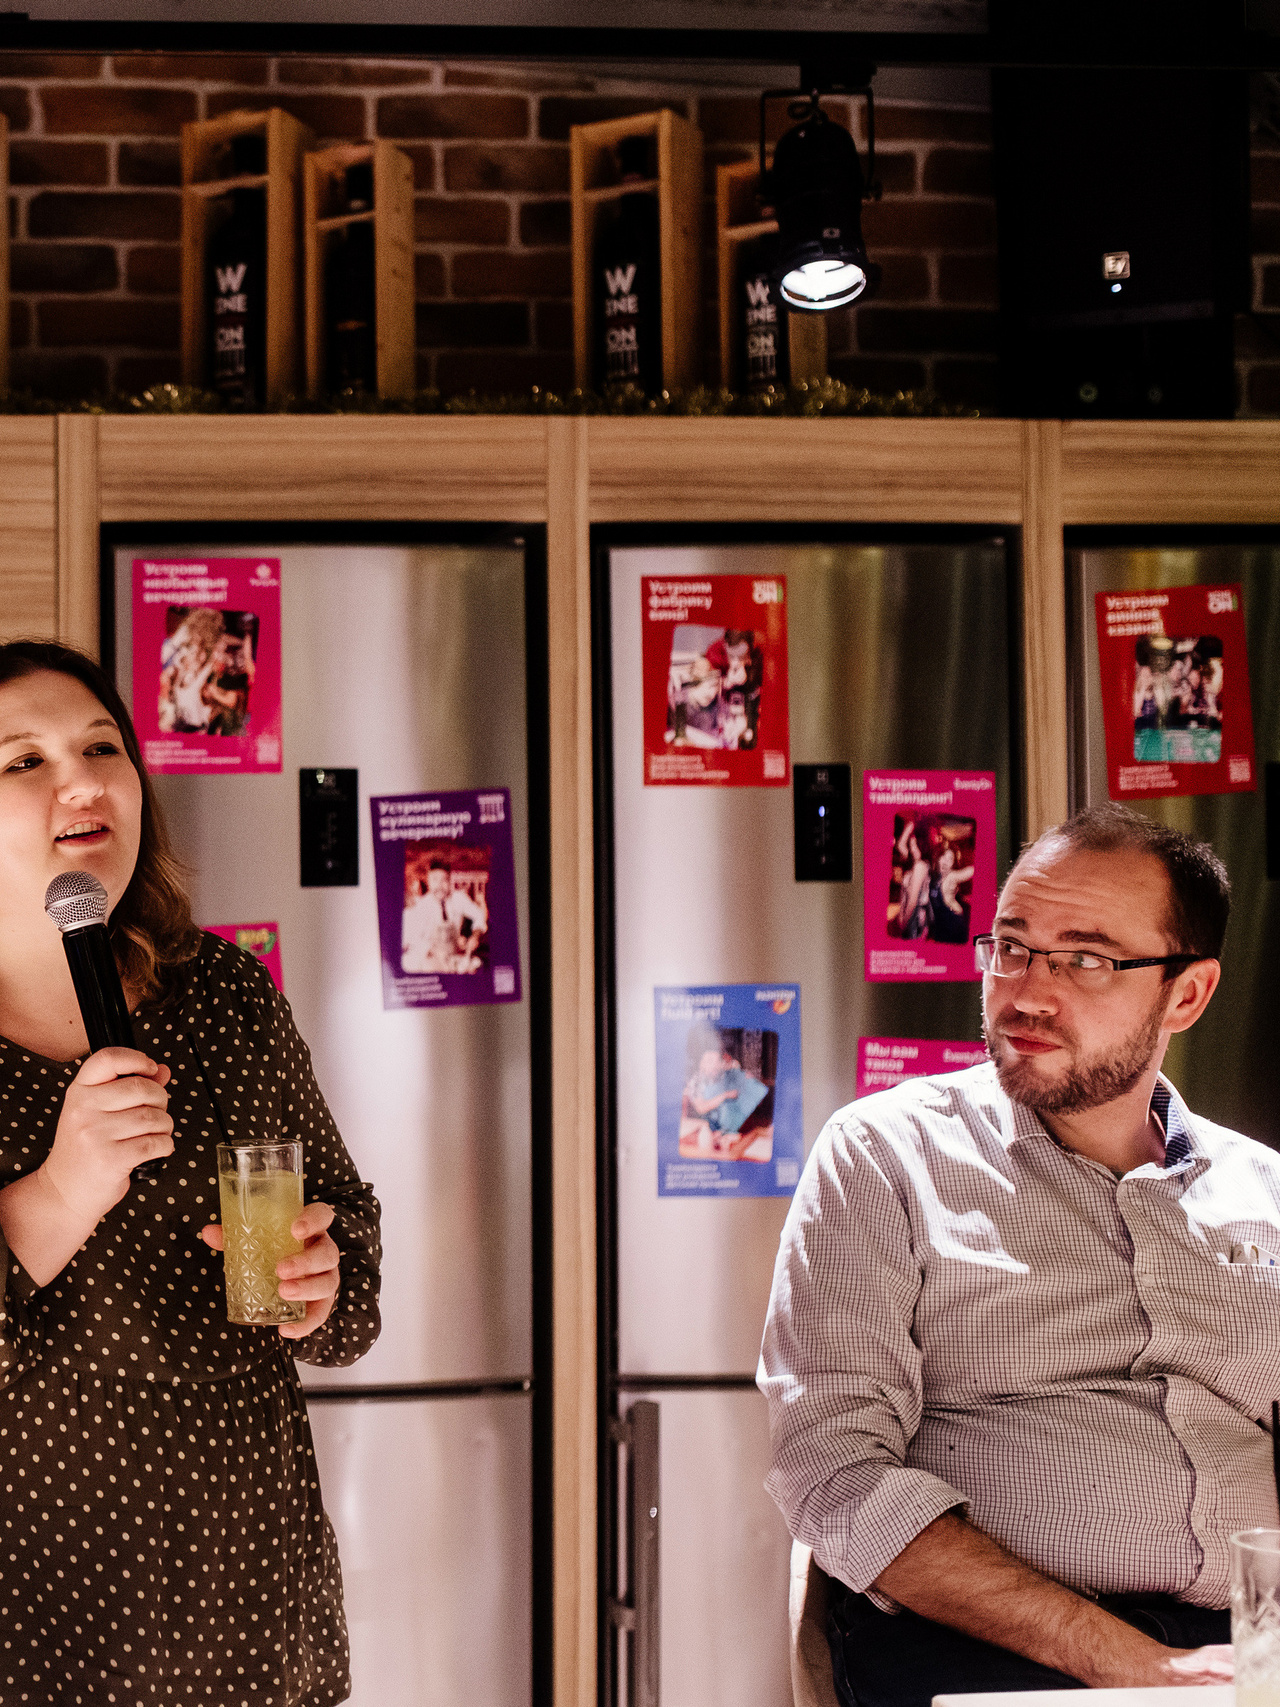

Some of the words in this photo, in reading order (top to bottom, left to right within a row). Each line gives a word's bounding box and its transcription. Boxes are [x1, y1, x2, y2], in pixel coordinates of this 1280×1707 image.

[214, 262, 248, 295] W
[604, 262, 638, 297] W
[143, 563, 208, 577] Устроим
[649, 580, 712, 596] Устроим
[1106, 594, 1169, 611] Устроим
[869, 776, 927, 792] Устроим
[869, 790, 953, 806] тимбилдинг!
[379, 799, 441, 817] Устроим
[379, 811, 471, 830] кулинарную
[380, 823, 464, 843] вечеринку!
